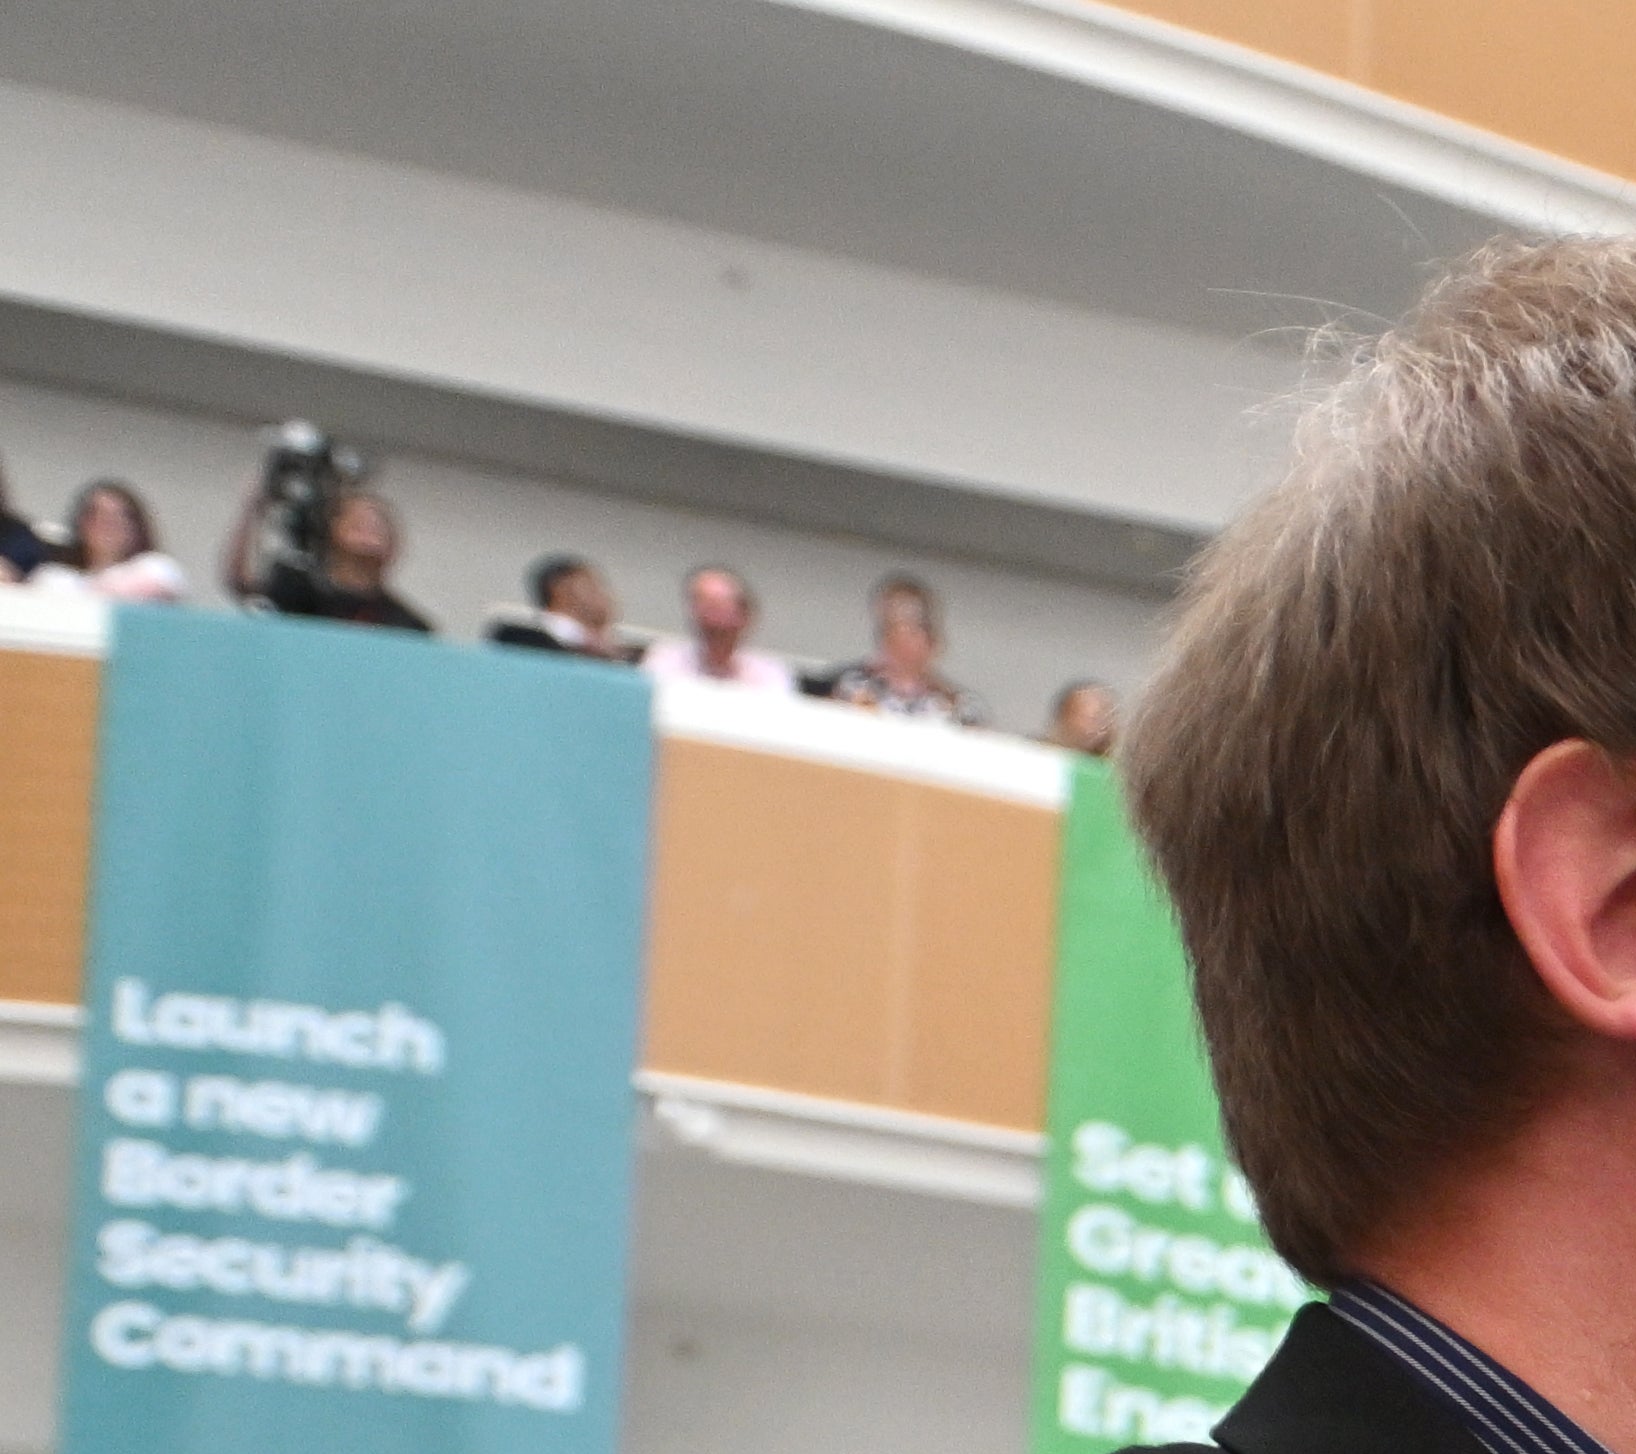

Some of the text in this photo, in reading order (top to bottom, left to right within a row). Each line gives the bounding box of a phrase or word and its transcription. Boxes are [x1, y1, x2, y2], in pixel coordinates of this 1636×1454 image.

[112, 976, 446, 1075] Launch
[104, 1070, 384, 1148] a new
[103, 1137, 406, 1230] Border
[1072, 1121, 1210, 1215] Set
[96, 1219, 470, 1335] Security
[91, 1300, 586, 1413] Command
